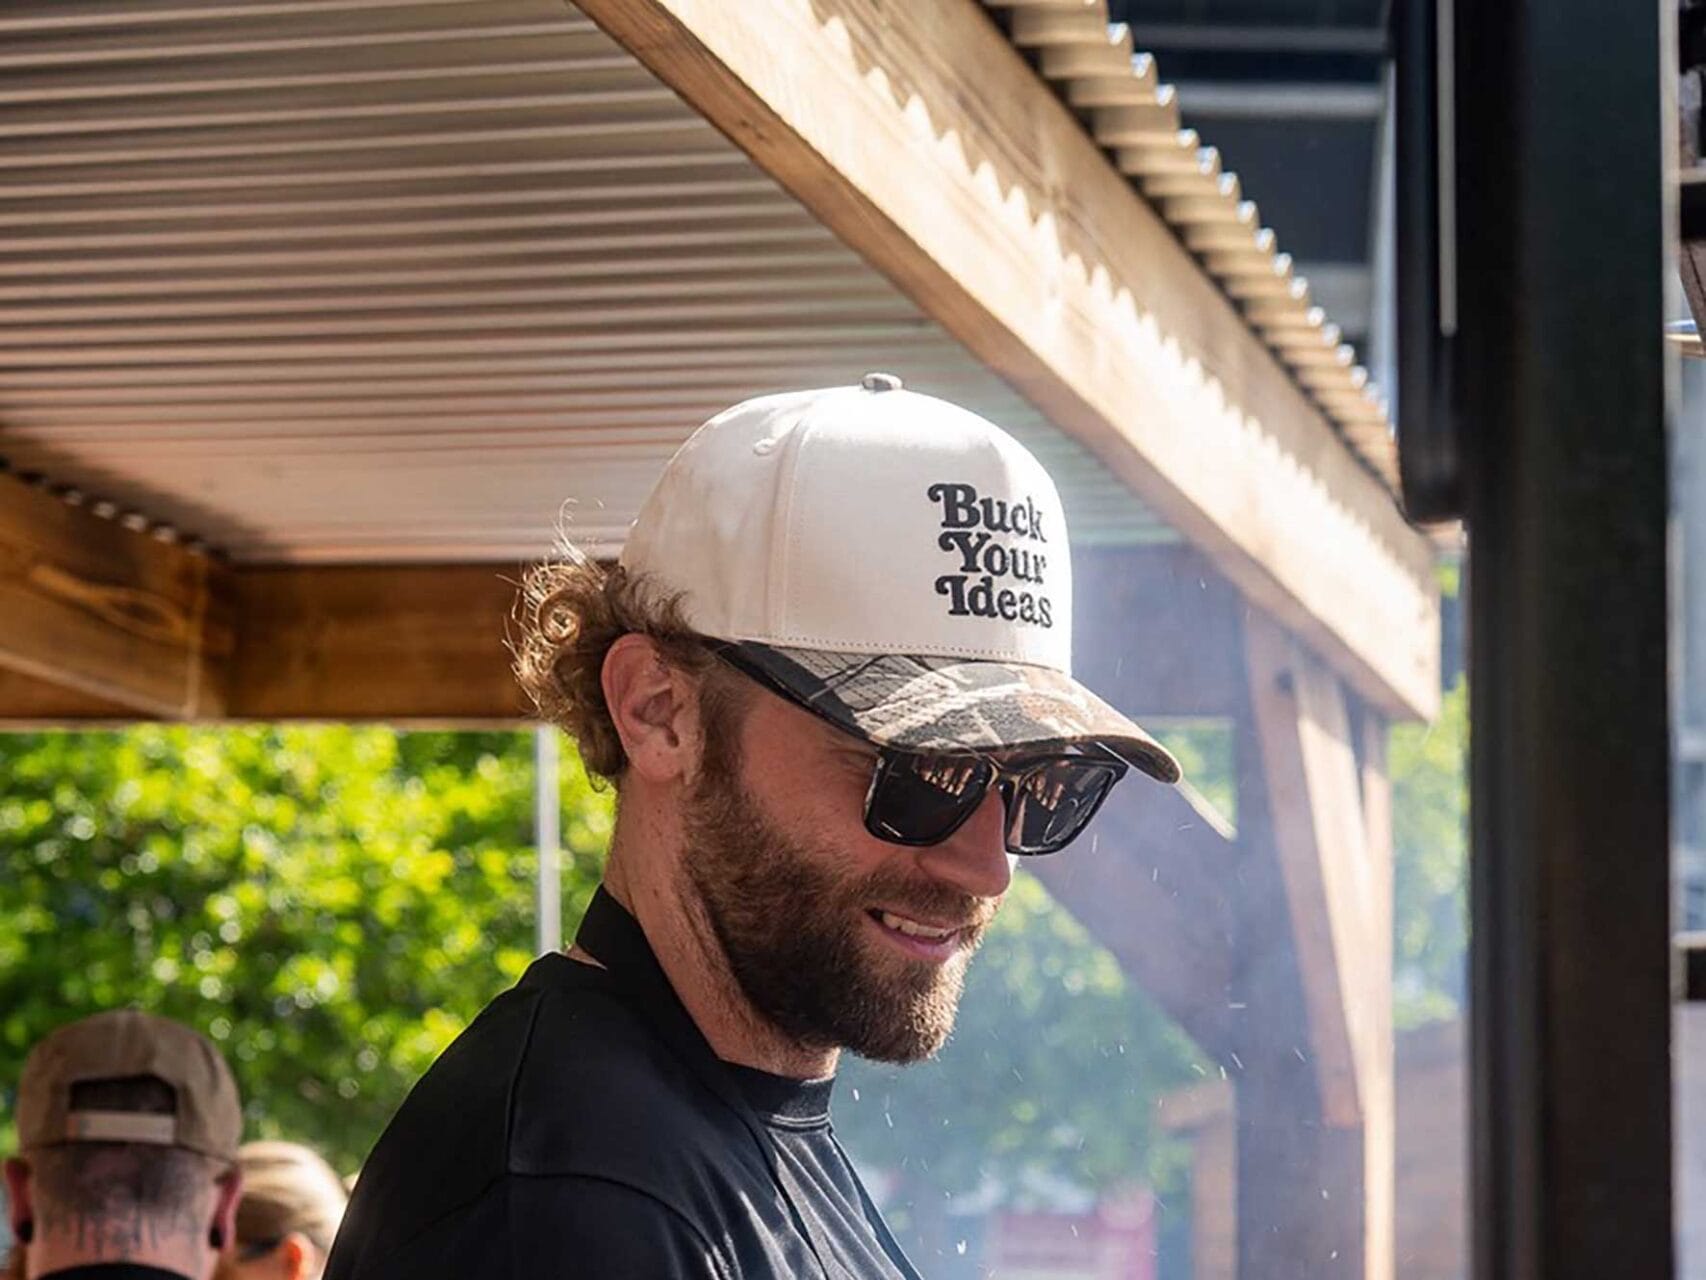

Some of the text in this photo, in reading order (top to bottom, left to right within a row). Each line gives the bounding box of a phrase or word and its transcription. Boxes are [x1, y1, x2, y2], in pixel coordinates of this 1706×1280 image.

[927, 483, 1047, 543] Buck
[938, 531, 1047, 584] Your
[934, 575, 1053, 628] Ideas
